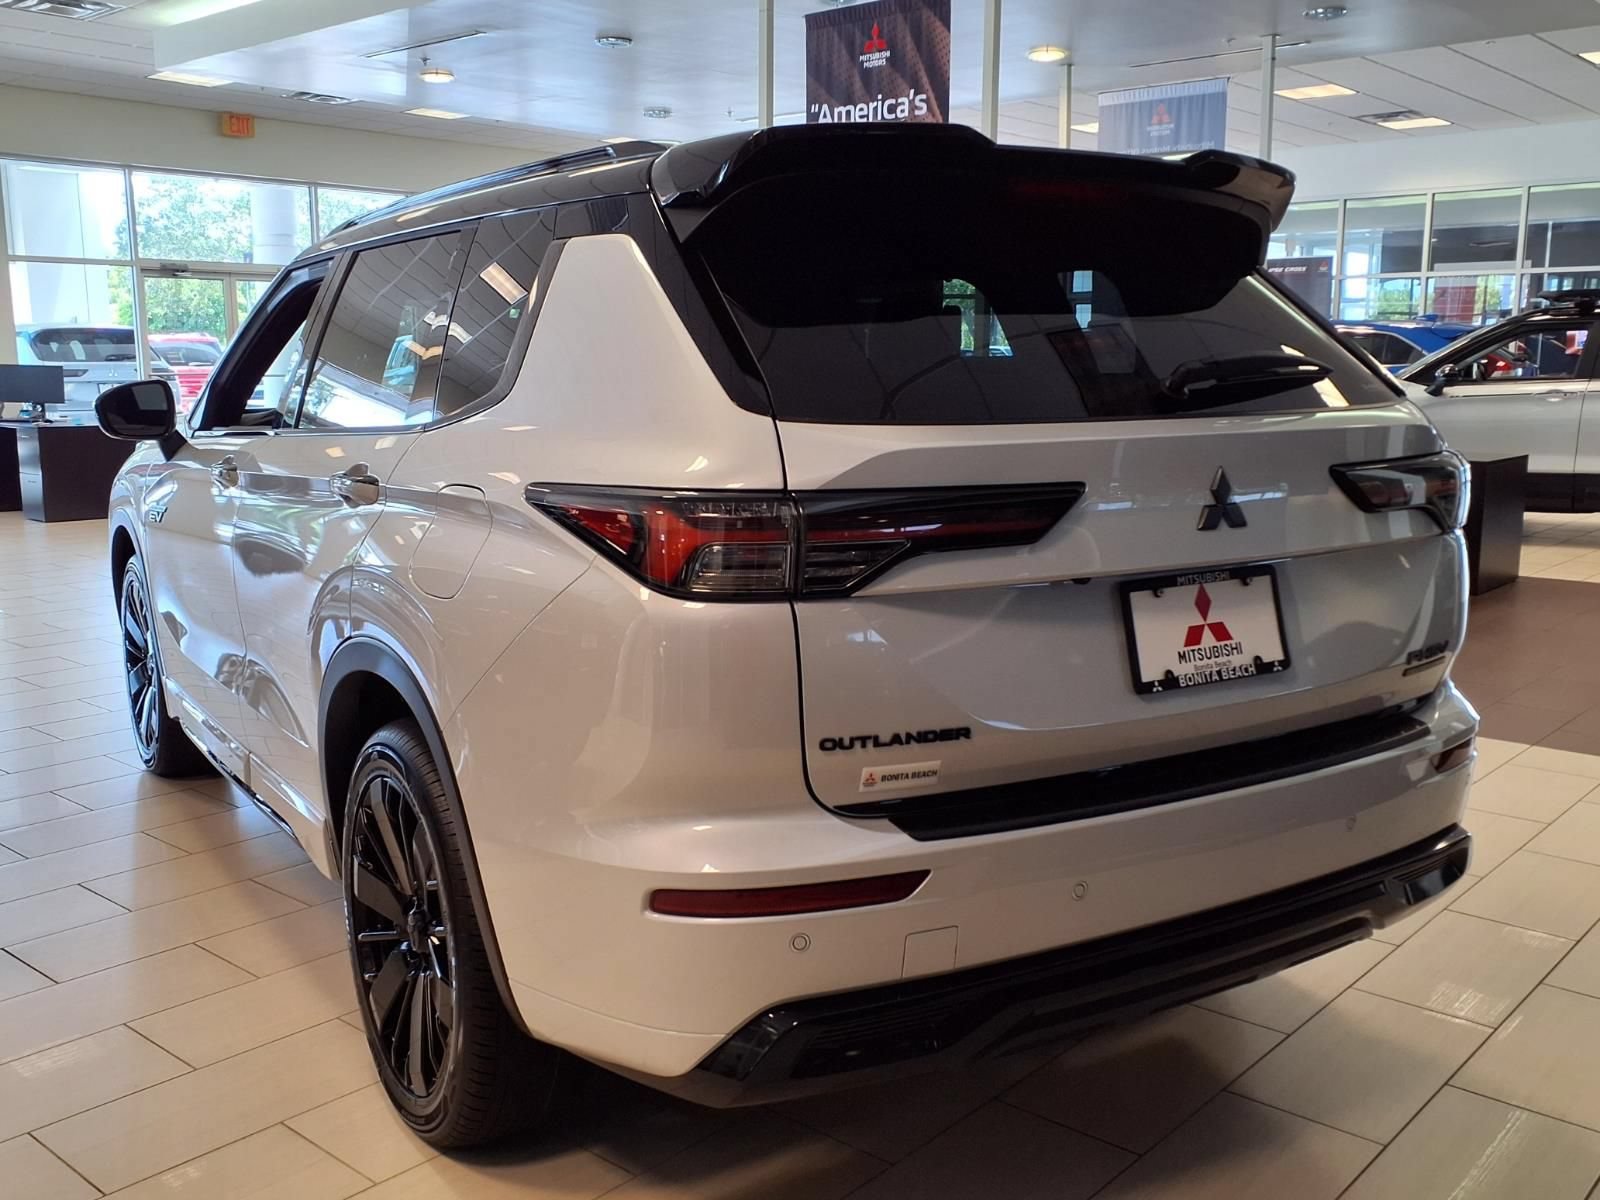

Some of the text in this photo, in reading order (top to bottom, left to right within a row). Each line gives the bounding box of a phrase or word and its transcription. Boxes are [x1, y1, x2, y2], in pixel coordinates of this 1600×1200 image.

[860, 50, 890, 62] MITSUBISHI
[863, 59, 886, 68] MOTORS
[1177, 571, 1231, 586] MITSUBISHI
[1177, 642, 1243, 664] MITSUBISHI
[1178, 664, 1257, 687] BONITA BEACH
[818, 726, 972, 752] OUTLANDER
[880, 769, 938, 783] BONITA BEACH
